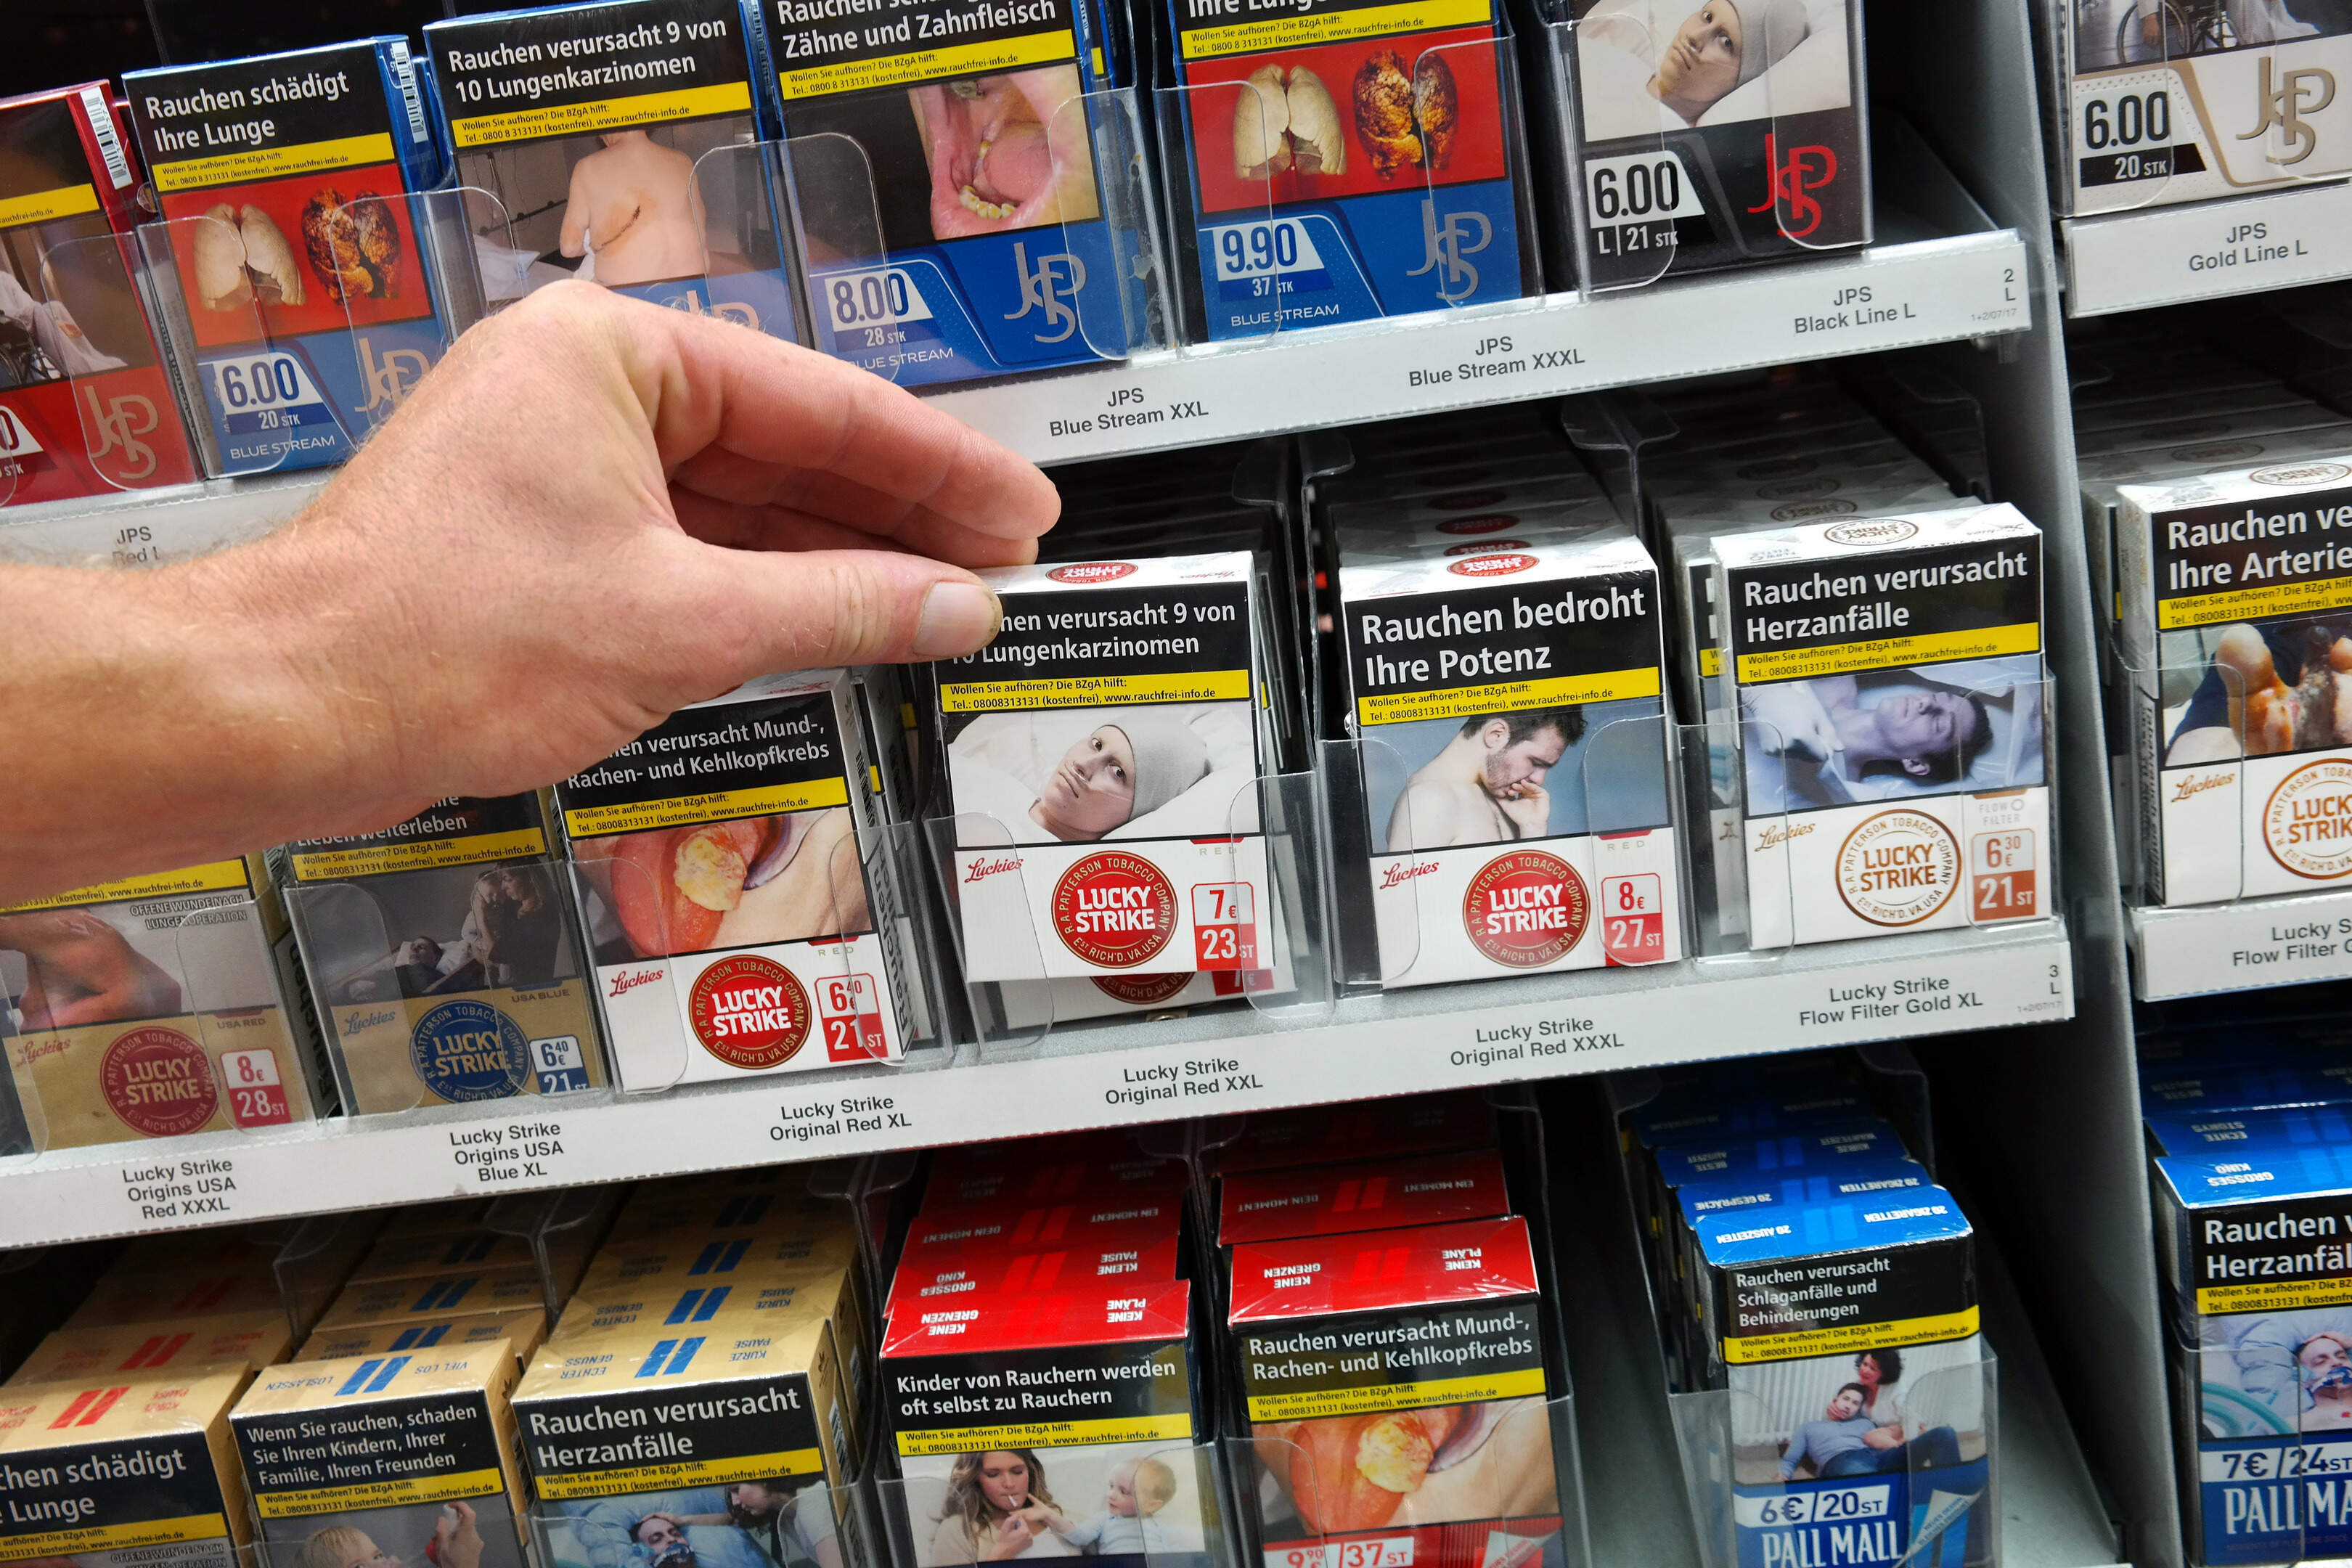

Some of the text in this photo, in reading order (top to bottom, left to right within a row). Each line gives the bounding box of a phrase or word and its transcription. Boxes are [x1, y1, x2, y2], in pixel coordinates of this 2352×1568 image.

[783, 0, 1055, 58] Zähne und Zahnfleisch
[448, 20, 726, 72] Rauchen verursacht 9 von
[455, 56, 695, 102] 10 Lungenkarzinomen
[145, 71, 349, 119] Rauchen schädigt
[2086, 91, 2171, 150] 6.00
[153, 119, 275, 152] Ihre Lunge
[1593, 160, 1680, 219] 6.00
[1626, 225, 1649, 251] 21
[1655, 231, 1679, 248] STK
[2226, 222, 2266, 243] JPS
[1222, 223, 1298, 274] 9.90
[2189, 240, 2308, 271] Gold Line L
[1252, 277, 1294, 297] 37 STK
[2004, 269, 2014, 282] 2
[1833, 286, 1871, 306] JPS
[2005, 287, 2017, 301] L
[1231, 304, 1340, 327] BLUE STREAM
[1794, 303, 1916, 333] Black Line L
[1475, 336, 1513, 356] JPS
[1409, 348, 1585, 386] Blue Stream XXXL
[1107, 388, 1144, 407] JPS
[1050, 401, 1209, 436] Blue Stream XXL
[116, 526, 152, 544] JPS
[1744, 551, 2028, 606] Rauchen verursacht
[1047, 603, 1235, 629] verursacht 9 von
[1362, 586, 1646, 644] Rauchen bedroht
[1747, 601, 1909, 642] Herzanfälle
[982, 636, 1199, 666] Lungenkarzinomen
[1366, 646, 1551, 686] Ihre Potenz
[950, 677, 1127, 695] Wollen Sie aufhören? Die BZgA hilft:
[951, 687, 1215, 709] Tel.: 08008313131 (kostenfrei), www.rauchfrei-info.de
[647, 724, 750, 752] verursacht
[754, 714, 824, 739] Mund-,
[567, 741, 829, 790] Rachen- und Kehlkopfkrebs
[1863, 843, 1935, 870] LUCKY
[964, 857, 1024, 883] Luckies
[1860, 865, 1937, 892] STRIKE
[1077, 886, 1151, 910] LUCKY
[1106, 857, 1154, 882] TOBACCO
[1153, 883, 1171, 931] COMPANY
[1488, 883, 1564, 911] LUCKY
[1075, 908, 1156, 934] STRIKE
[1486, 907, 1568, 935] STRIKE
[2271, 923, 2331, 941] Lucky
[2233, 944, 2337, 966] Flow Filter
[2049, 965, 2059, 977] 3
[1829, 977, 1949, 1002] Lucky Strike
[2050, 982, 2061, 995] L
[1800, 992, 1983, 1026] Flow Filter Gold XL
[1476, 1018, 1593, 1042] Lucky Strike
[1450, 1033, 1624, 1066] Original Red XXXL
[1124, 1058, 1238, 1082] Lucky Strike
[1106, 1074, 1263, 1105] Original Red XXL
[781, 1096, 894, 1119] Lucky Strike
[449, 1122, 560, 1146] Lucky Strike
[770, 1113, 912, 1141] Original Red XL
[454, 1140, 563, 1166] Origins USA
[122, 1159, 232, 1183] Lucky Strike
[478, 1162, 547, 1182] Blue XL
[128, 1177, 236, 1202] Origins USA
[142, 1197, 230, 1219] Red XXXL
[1863, 1205, 1948, 1223] 20 ZIGARETTEN
[1715, 1225, 1792, 1244] 20 AUSZEITEN
[1736, 1257, 1890, 1287] Rauchen verursacht
[1106, 1298, 1146, 1310] PLÄNE
[1738, 1278, 1877, 1307] Schlaganfälle und
[921, 1310, 979, 1324] GRENZEN
[1106, 1311, 1143, 1323] KEINE
[1739, 1304, 1859, 1326] Behinderungen
[928, 1323, 966, 1336] KEINE
[560, 1367, 608, 1380] ECHTER
[565, 1354, 613, 1367] GENUSS
[897, 1360, 1175, 1392] Kinder von Rauchern werden
[901, 1389, 1112, 1416] oft selbst zu Rauchern
[246, 1405, 476, 1442] Wenn Sie rauchen, schaden
[253, 1432, 446, 1464] Sie Ihren Kindern, Ihrer
[258, 1453, 455, 1485] Familie, Ihren Freunden
[1761, 1521, 1903, 1568] PALL MALL
